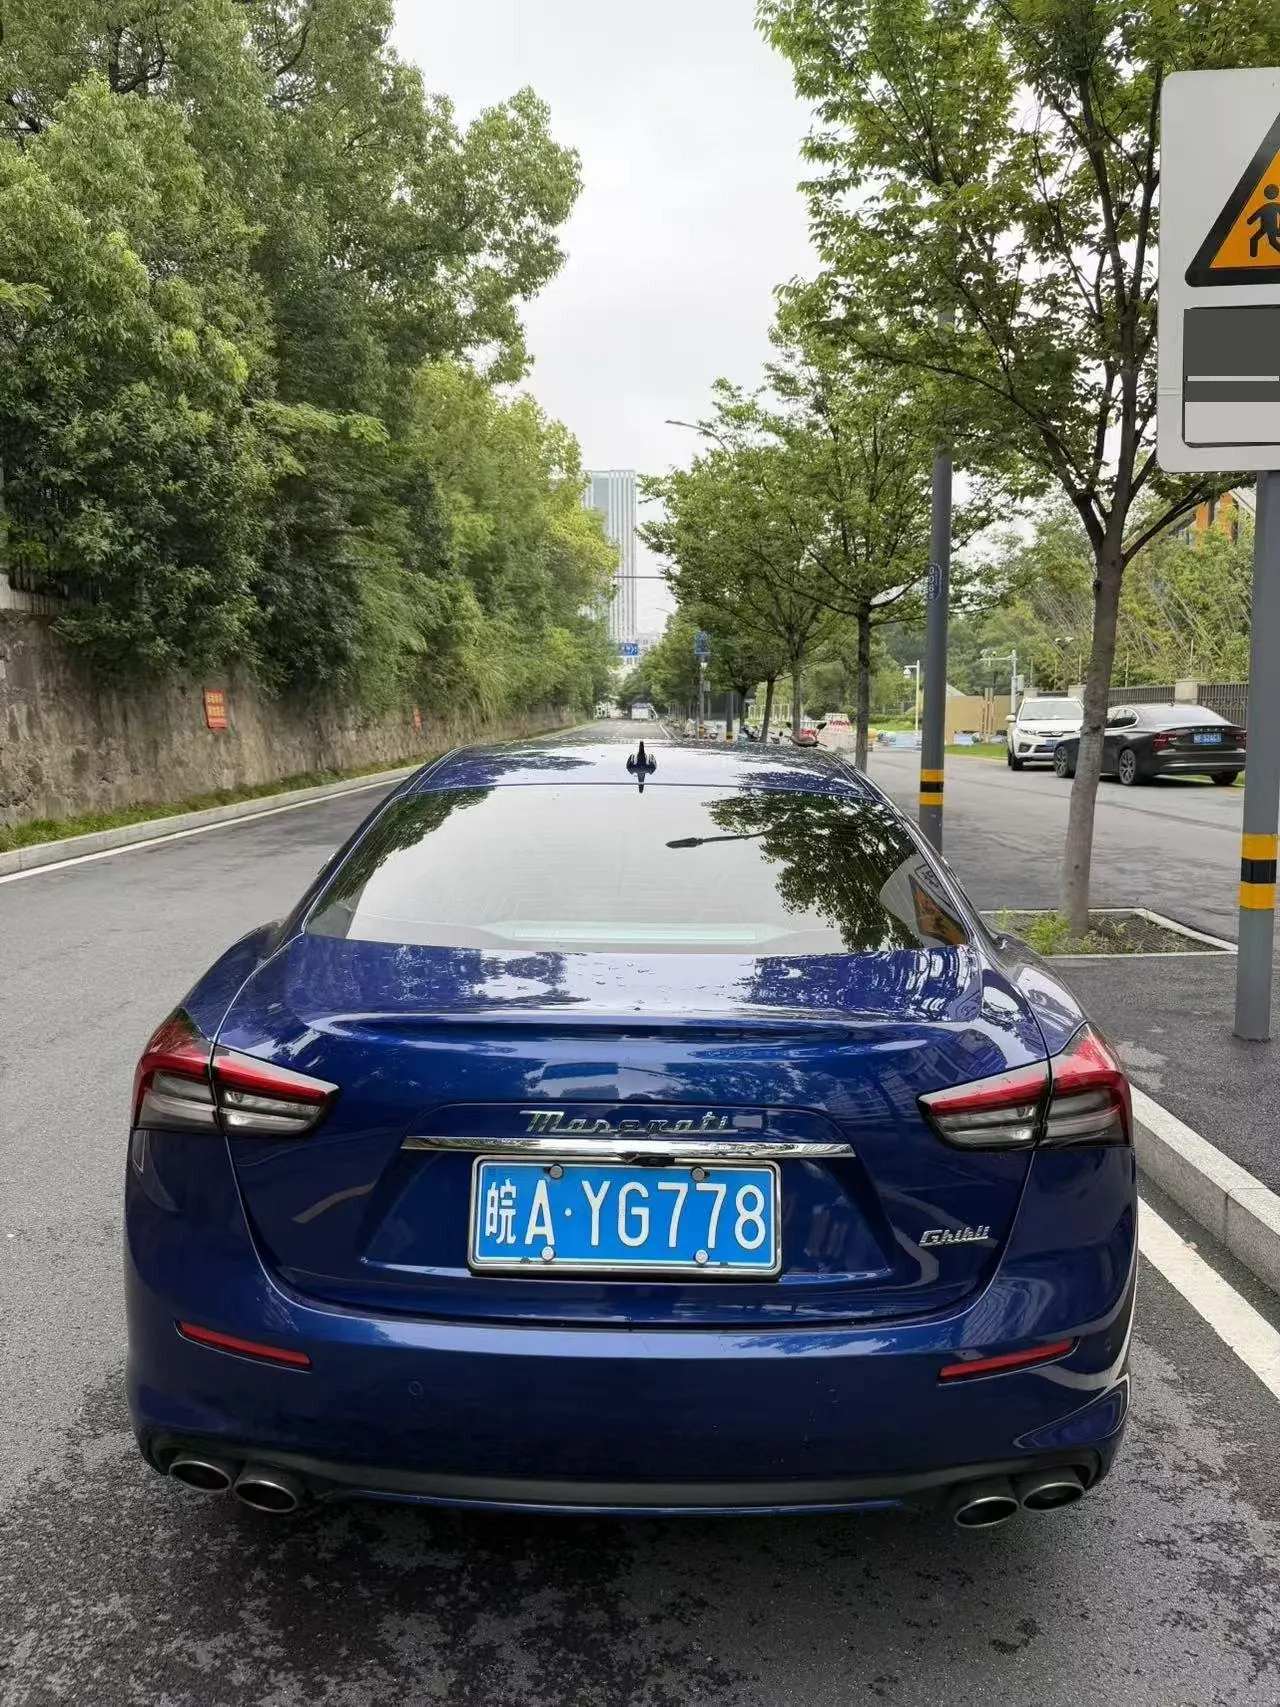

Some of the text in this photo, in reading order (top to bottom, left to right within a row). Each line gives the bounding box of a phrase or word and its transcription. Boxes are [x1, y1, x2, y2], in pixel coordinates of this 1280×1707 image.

[519, 1110, 738, 1134] Maserati
[485, 1178, 767, 1251] 皖A·YG778
[918, 1225, 990, 1247] Ghibli
